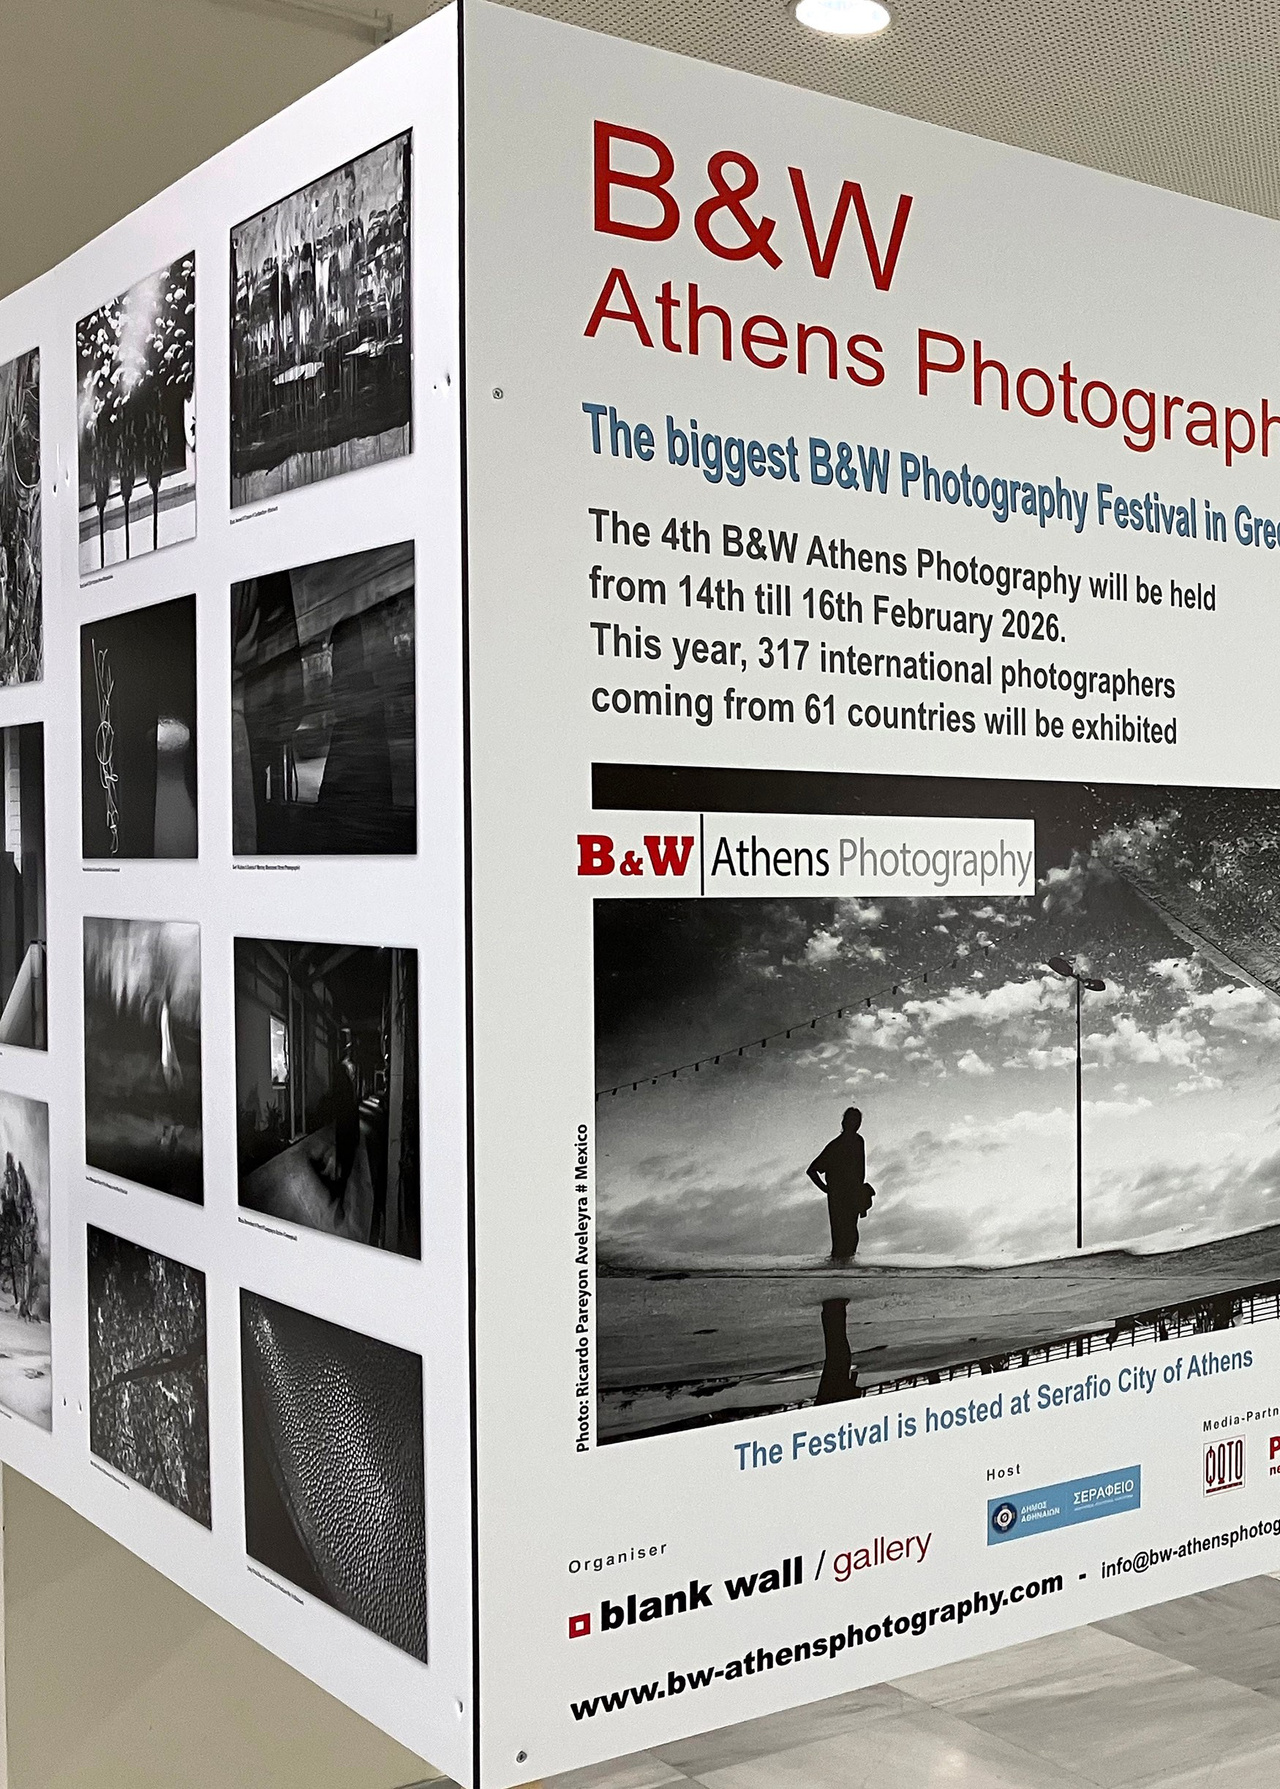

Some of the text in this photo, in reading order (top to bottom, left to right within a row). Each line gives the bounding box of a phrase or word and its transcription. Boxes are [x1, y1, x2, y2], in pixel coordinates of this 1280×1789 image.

[594, 120, 913, 291] B&W
[584, 268, 884, 386] Athens
[582, 402, 654, 461] The
[666, 415, 800, 486] biggest
[809, 437, 890, 494] B&W
[900, 452, 1088, 533] Photography
[1097, 483, 1196, 538] Festival
[1205, 500, 1226, 542] in
[588, 508, 1215, 611] The 4th B&W Athens Photography will be held
[589, 565, 1065, 643] from 14th till 16th February 2026.
[590, 622, 1175, 701] This year, 317 international photographers
[592, 688, 1176, 744] coming from 61 countries will be exhibited
[577, 834, 1032, 887] B&W Athens Photography
[574, 1124, 588, 1180] Mexico
[574, 1196, 592, 1265] Aveleyra
[575, 1269, 592, 1334] Pareyon
[575, 1336, 589, 1398] Ricardo
[575, 1399, 590, 1453] Photo:
[734, 1350, 1252, 1470] The Festival is hosted at Serafio City of Athens
[987, 1464, 1020, 1481] Host
[1073, 1479, 1134, 1505] ΣΕΡΑΦΕΙΟ
[569, 1544, 666, 1573] Organiser
[601, 1580, 713, 1631] blank
[724, 1556, 802, 1600] wall
[834, 1533, 931, 1582] gallery
[570, 1573, 1064, 1722] www.bw-athensphotography.com
